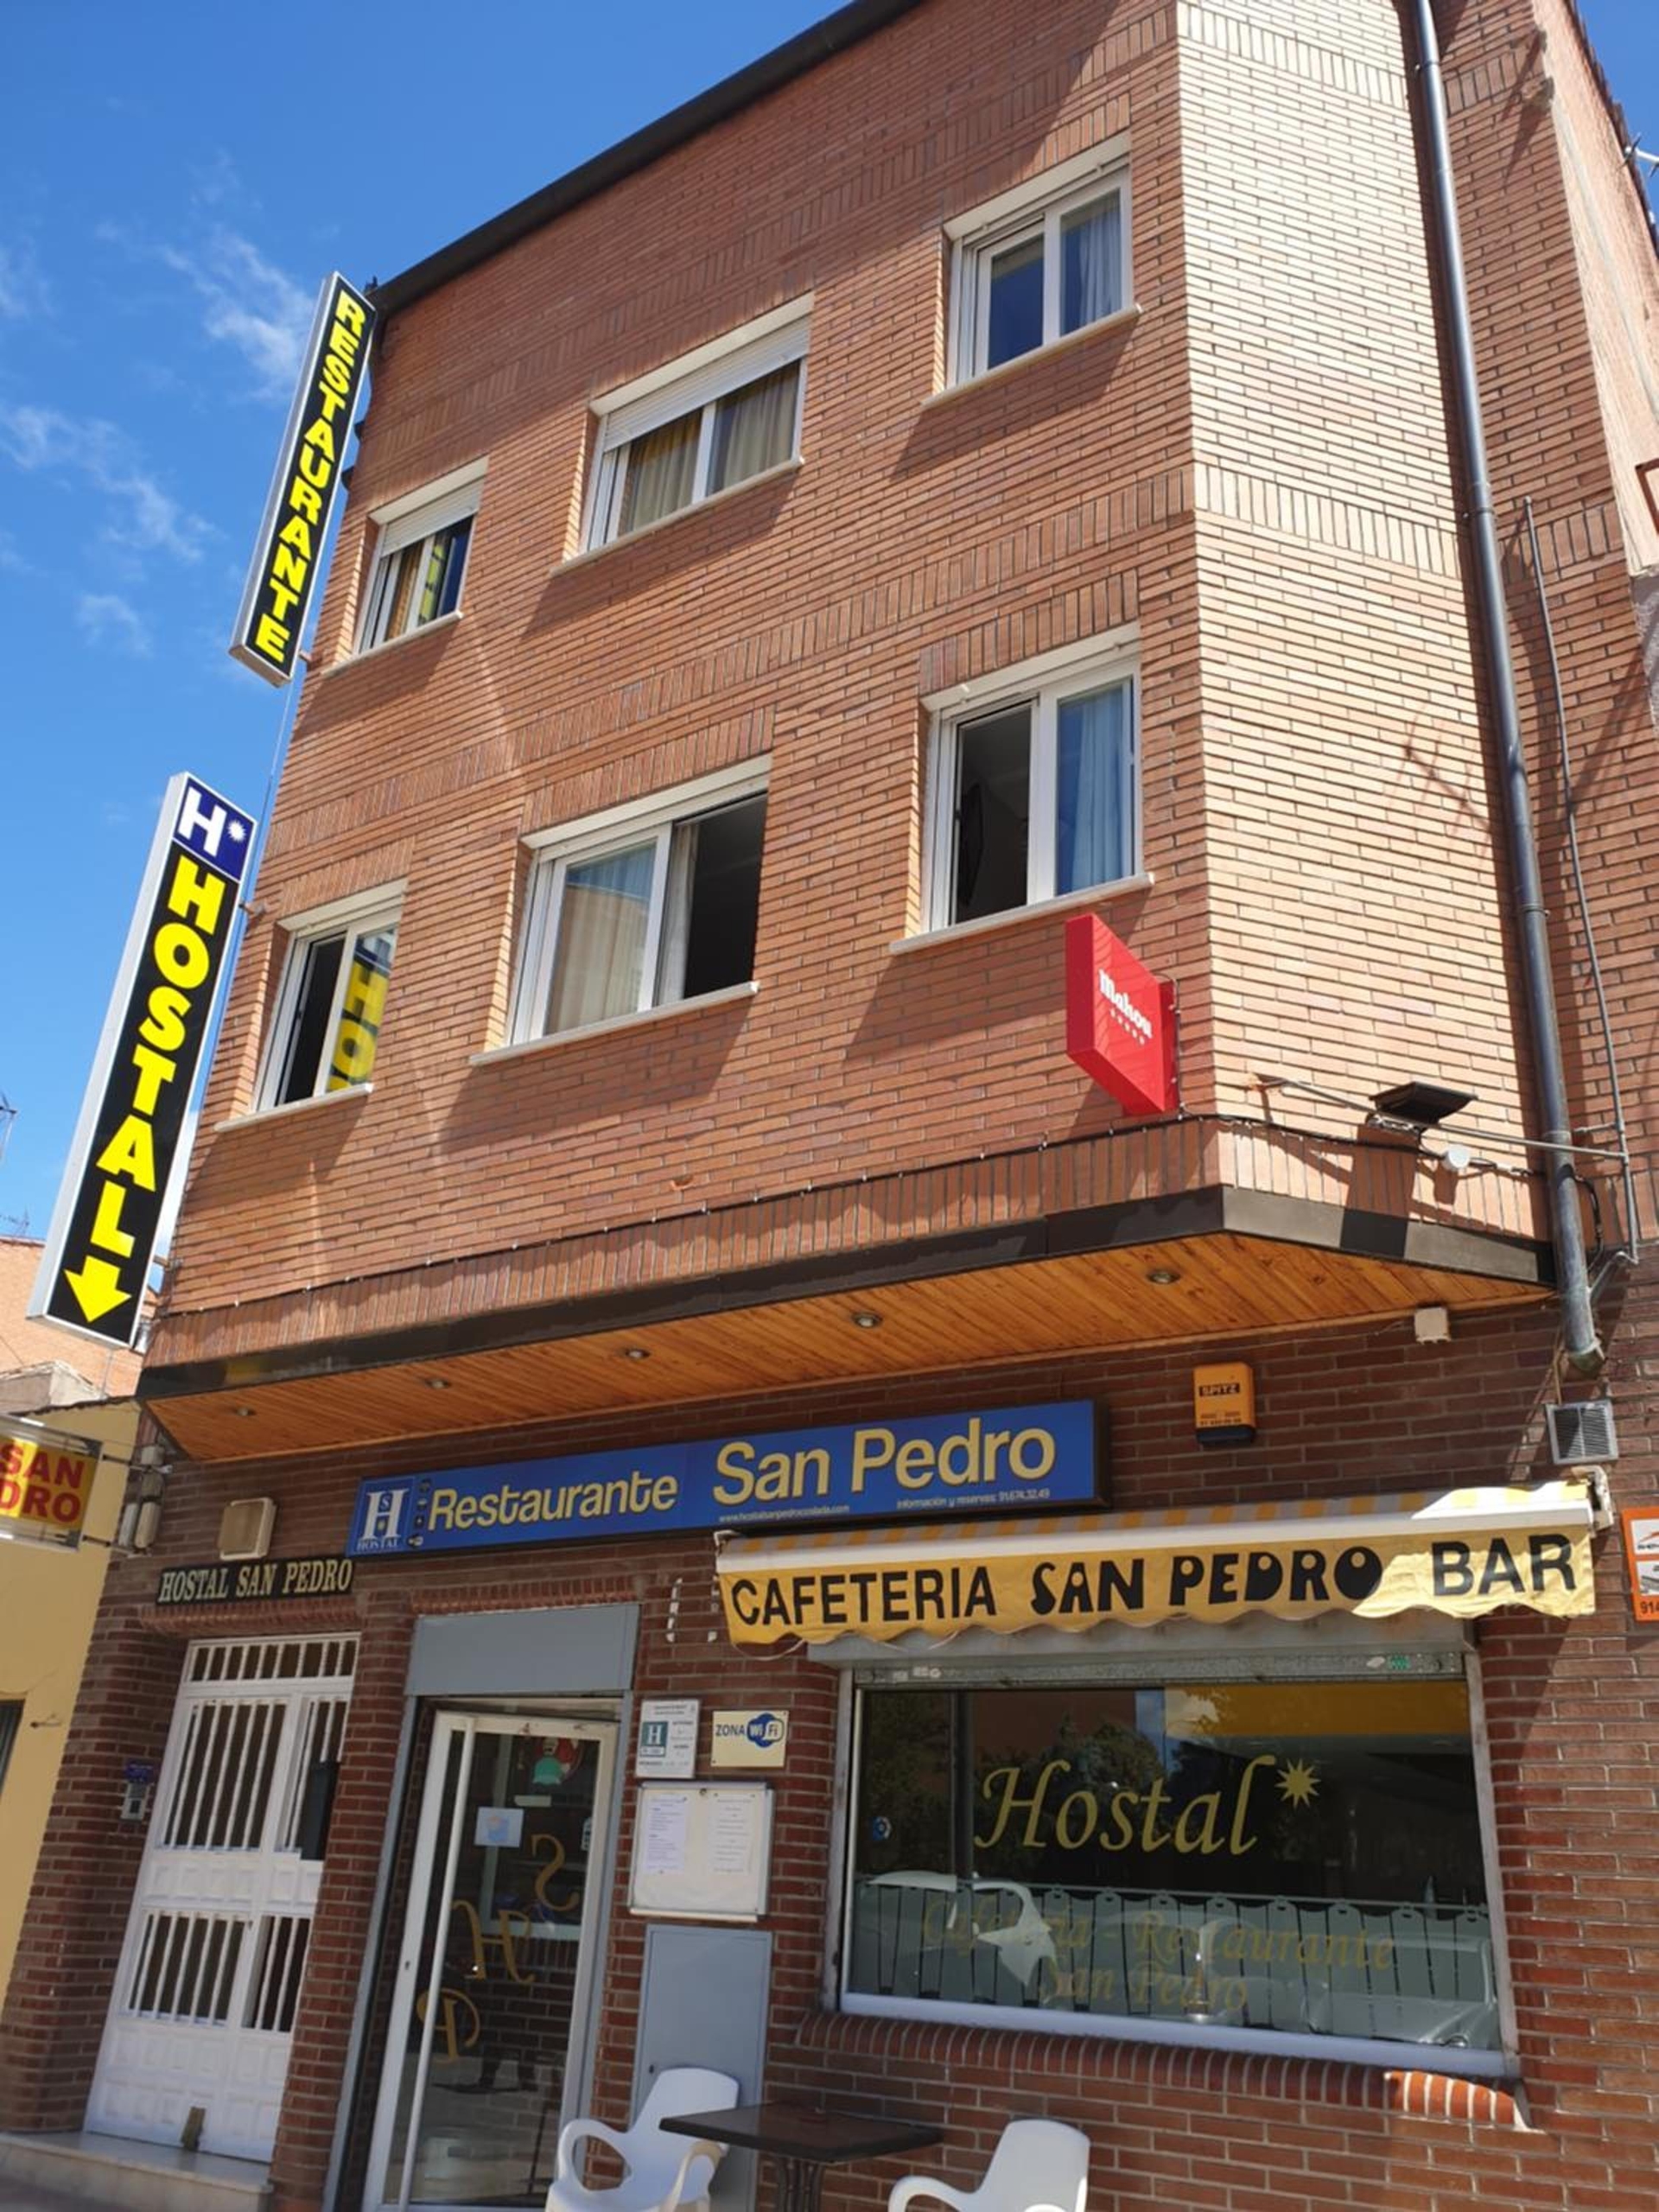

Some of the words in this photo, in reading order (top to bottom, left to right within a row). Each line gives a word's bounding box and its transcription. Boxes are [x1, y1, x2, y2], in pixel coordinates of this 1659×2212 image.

[255, 289, 365, 664] RESTAURANTE
[178, 786, 219, 857] H
[96, 855, 226, 1260] HOSTAL
[0, 1443, 85, 1489] SAN
[713, 1441, 832, 1505] San
[851, 1418, 1057, 1492] Pedro
[427, 1470, 678, 1532] Restaurante
[356, 1537, 399, 1552] HOSTAL
[731, 1566, 997, 1626] CAFETERIA
[1031, 1558, 1145, 1616] SAN
[1169, 1545, 1382, 1605] PEDRO
[1431, 1533, 1576, 1598] BAR
[157, 1567, 230, 1603] HOSTAL
[235, 1564, 277, 1598] SAN
[282, 1558, 353, 1594] PEDRO
[715, 1724, 744, 1737] ZONA
[974, 1754, 1277, 1856] Hostal
